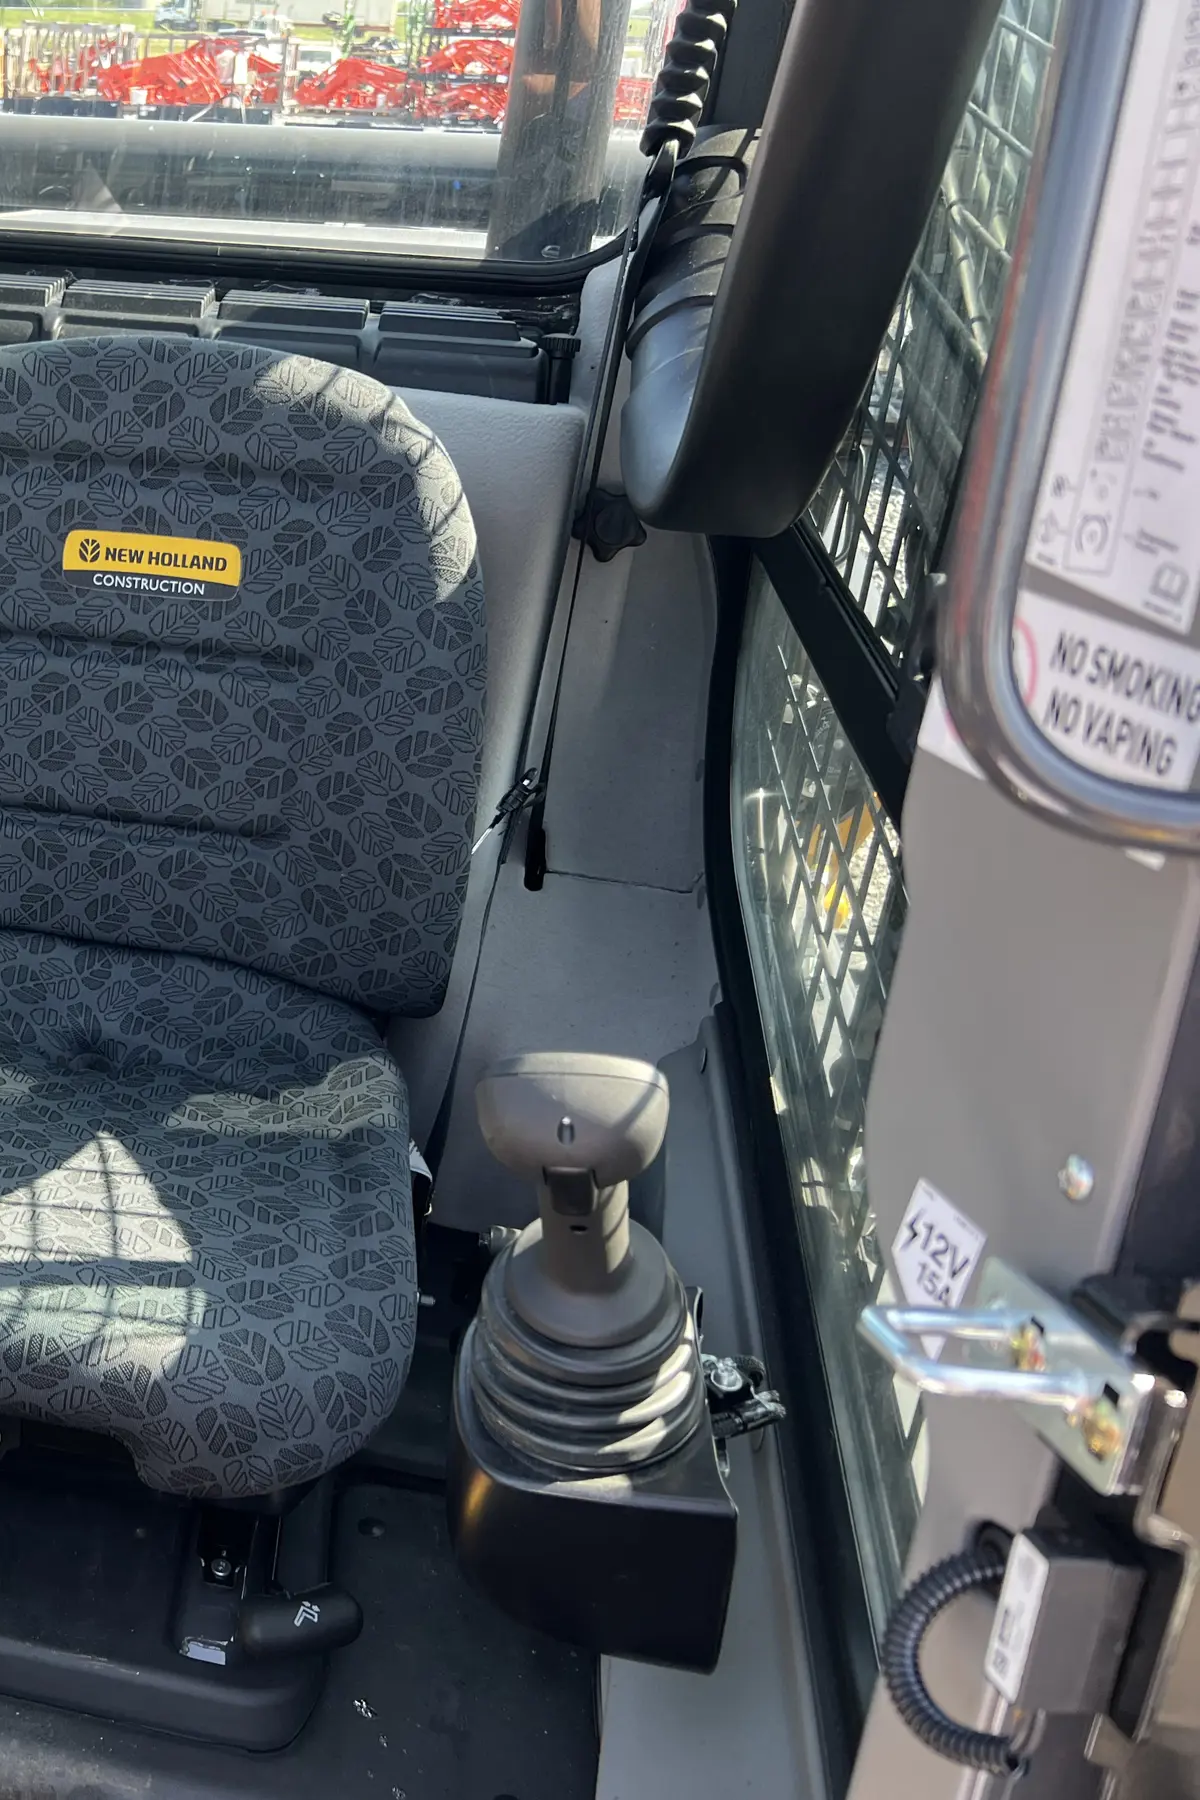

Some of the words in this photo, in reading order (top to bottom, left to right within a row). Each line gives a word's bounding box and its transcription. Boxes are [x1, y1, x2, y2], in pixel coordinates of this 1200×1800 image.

[93, 573, 205, 596] CONSTRUCTION
[105, 546, 144, 564] NEW
[148, 551, 227, 572] HOLLAND
[1049, 630, 1089, 678] NO
[1085, 645, 1200, 724] SMOKING
[1042, 686, 1082, 735] NO
[1081, 702, 1178, 776] VAPING
[920, 1222, 970, 1279] 12V
